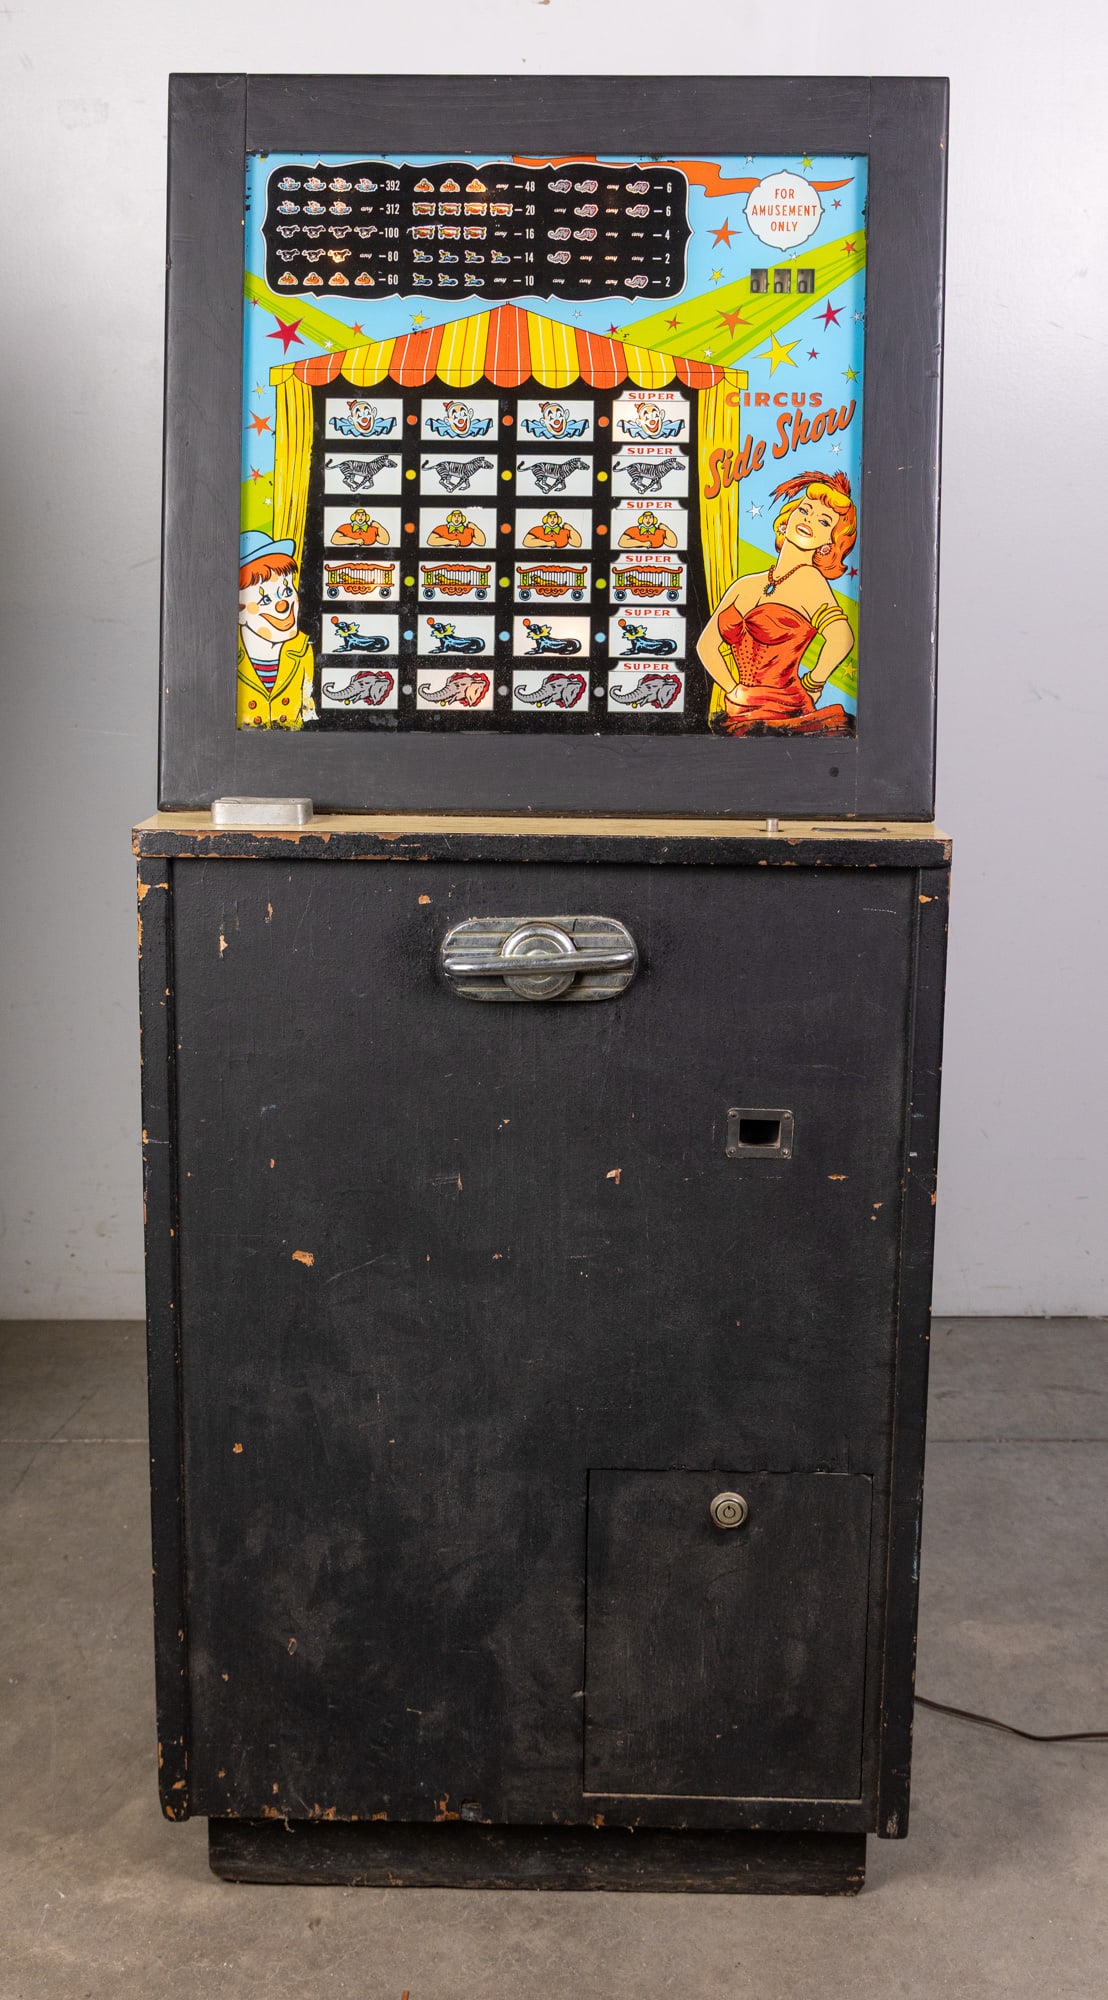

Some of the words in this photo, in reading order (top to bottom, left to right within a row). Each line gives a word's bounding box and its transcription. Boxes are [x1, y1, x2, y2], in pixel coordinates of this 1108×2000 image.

[775, 188, 795, 199] FOR
[752, 204, 817, 217] AMUSEMENT
[770, 221, 798, 232] ONLY
[628, 392, 675, 400] SUPER
[726, 392, 823, 408] CIRCUS
[627, 447, 673, 455] SUPER
[704, 434, 767, 499] Side
[772, 400, 857, 460] Show
[626, 501, 673, 509] SUPER
[625, 555, 672, 563] SUPER
[623, 663, 670, 671] SUPER
